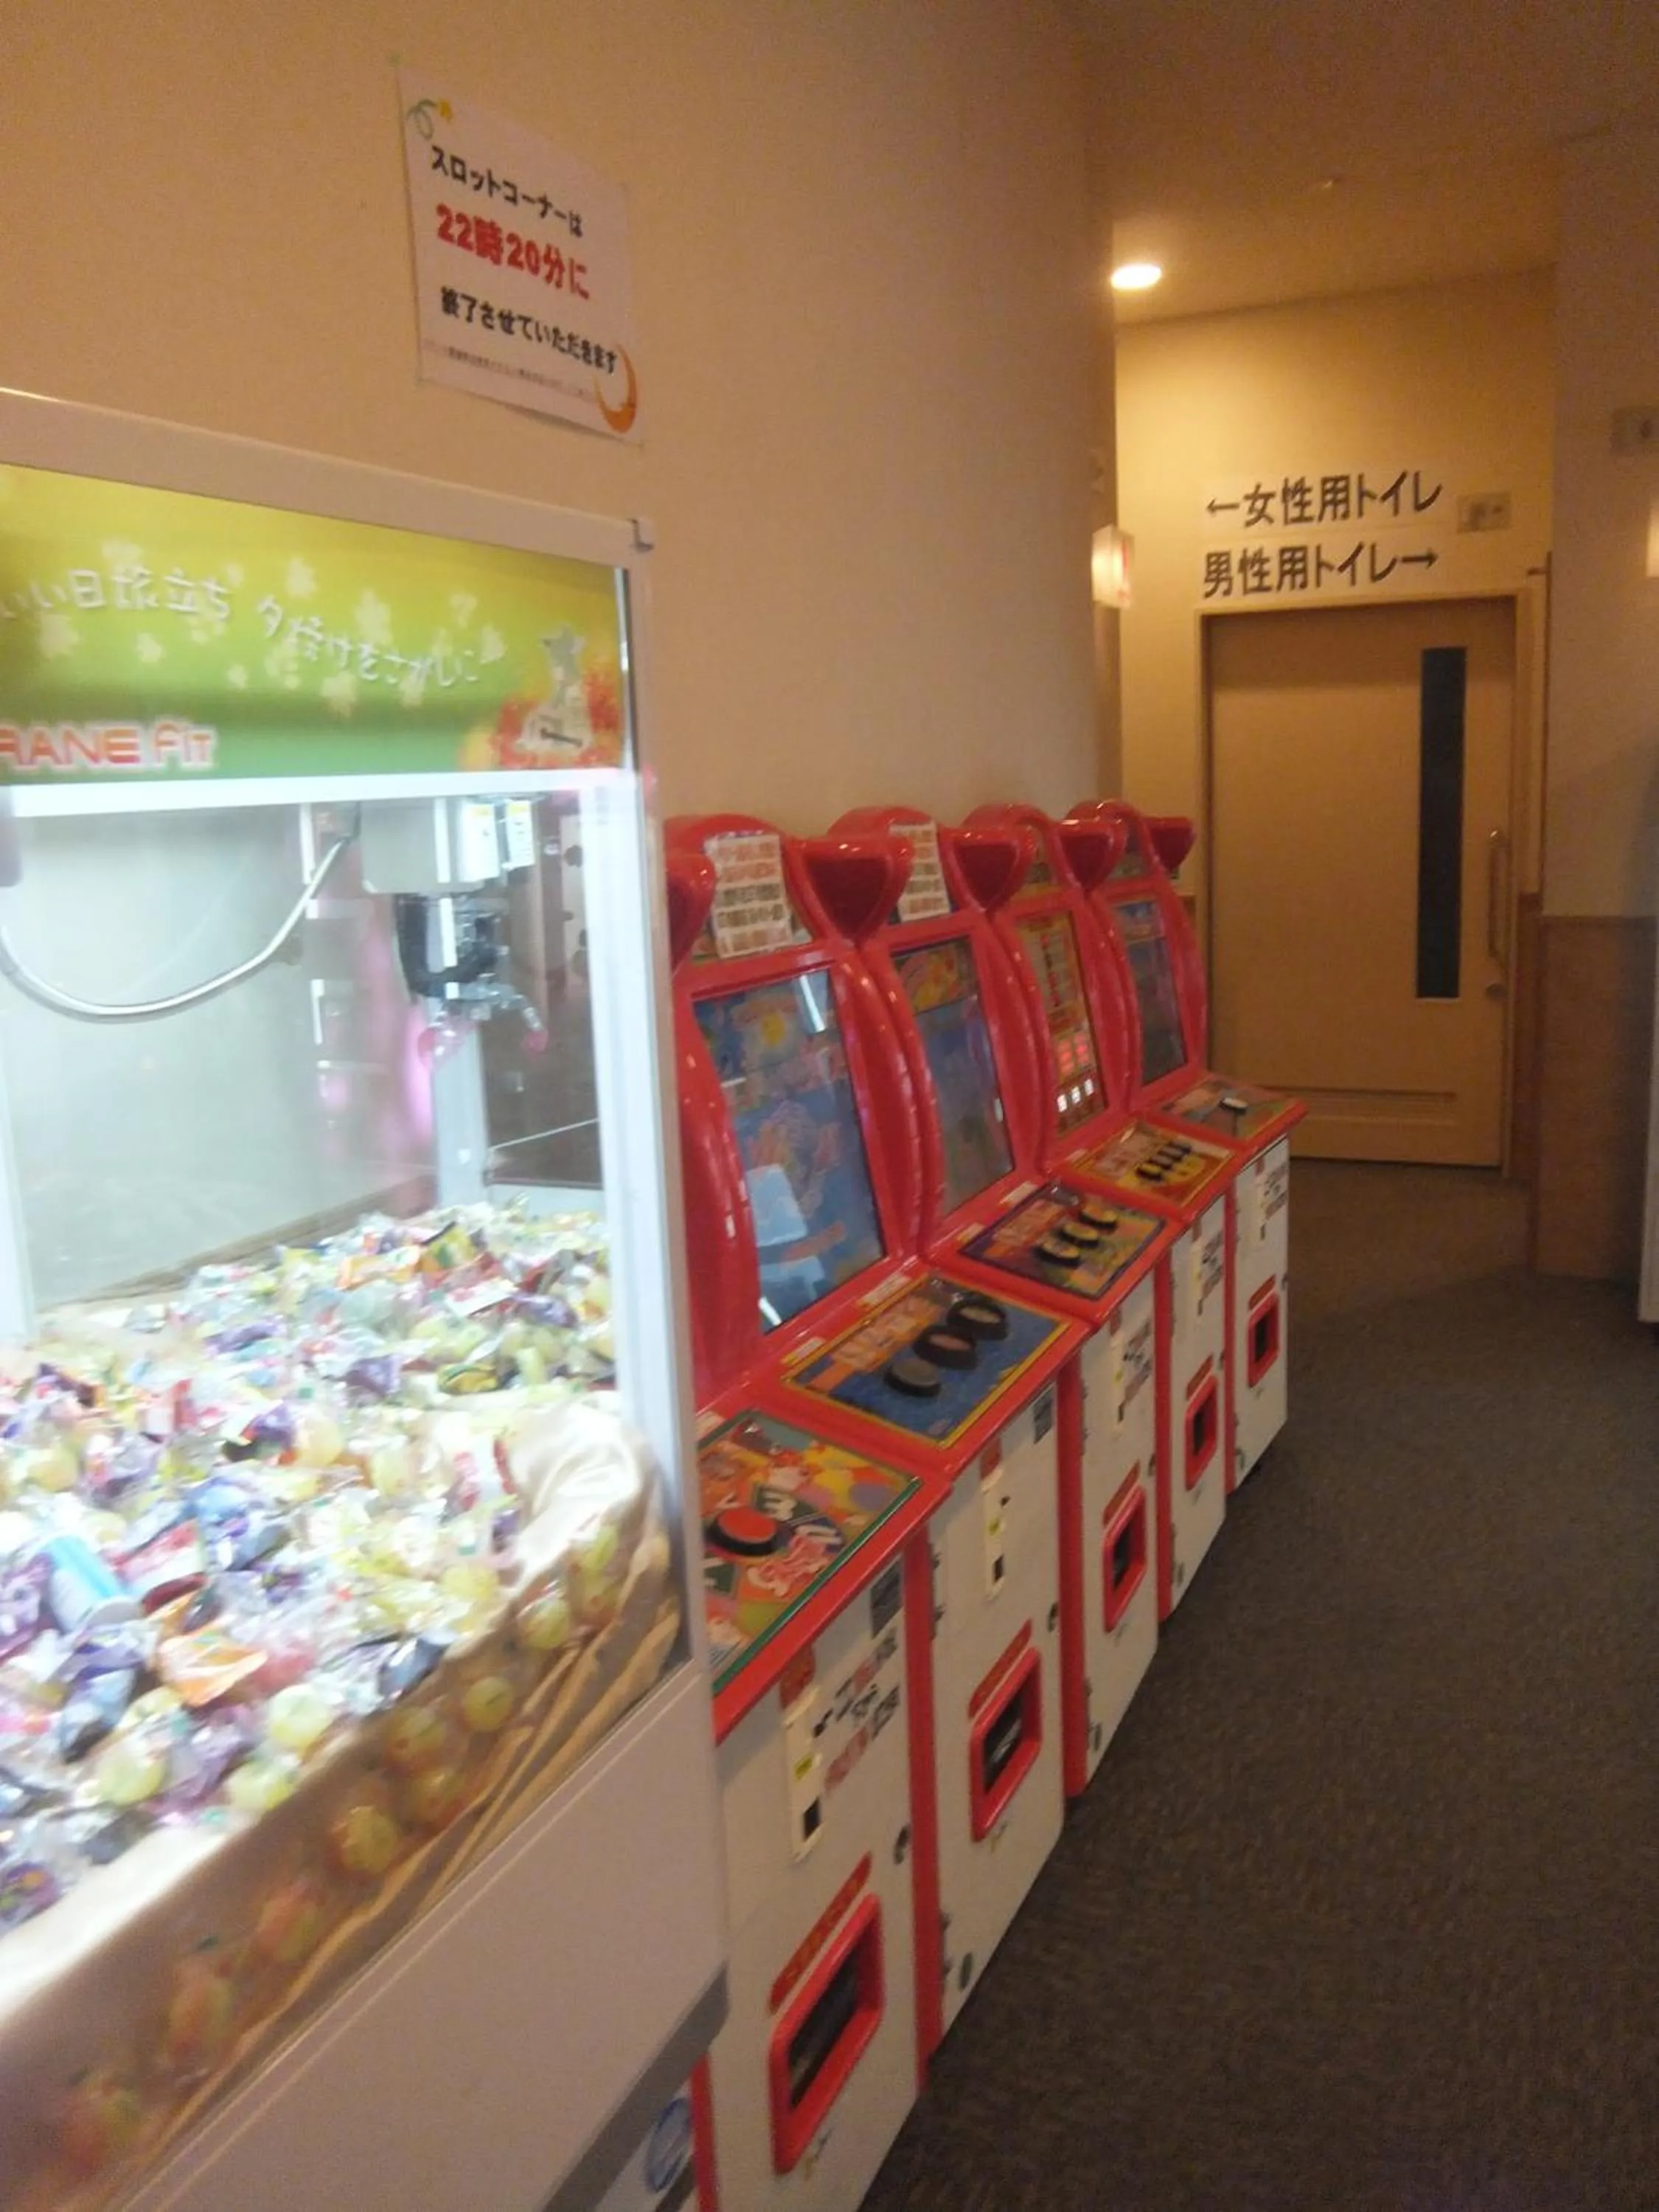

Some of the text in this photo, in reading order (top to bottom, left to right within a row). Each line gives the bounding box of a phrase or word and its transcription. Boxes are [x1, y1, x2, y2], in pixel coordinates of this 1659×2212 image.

[431, 145, 583, 237] スロットコーナーは
[436, 203, 590, 299] 22時20分に
[1243, 470, 1444, 528] 女性用トイレ
[1203, 541, 1398, 599] 男性用トイレ
